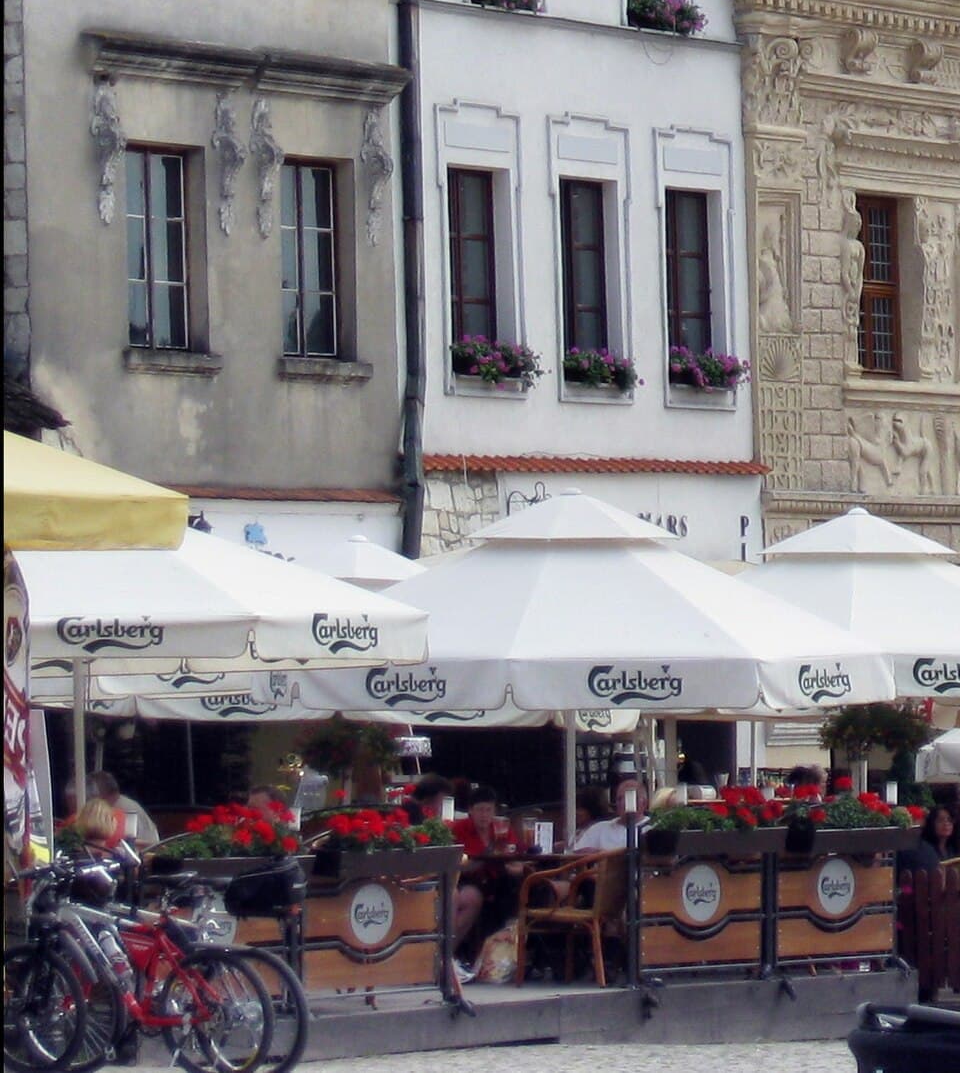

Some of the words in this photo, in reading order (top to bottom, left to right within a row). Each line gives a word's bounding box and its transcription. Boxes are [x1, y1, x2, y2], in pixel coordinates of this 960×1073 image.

[57, 616, 164, 645] Carlsberg
[312, 613, 378, 648] Carlsberg
[366, 667, 446, 700] Carlsberg
[588, 665, 682, 697] Carlsberg
[798, 664, 851, 696] Carlsberg
[685, 881, 717, 902] Carlsberg
[821, 875, 851, 896] Carlsberg
[354, 902, 389, 924] Carlsberg
